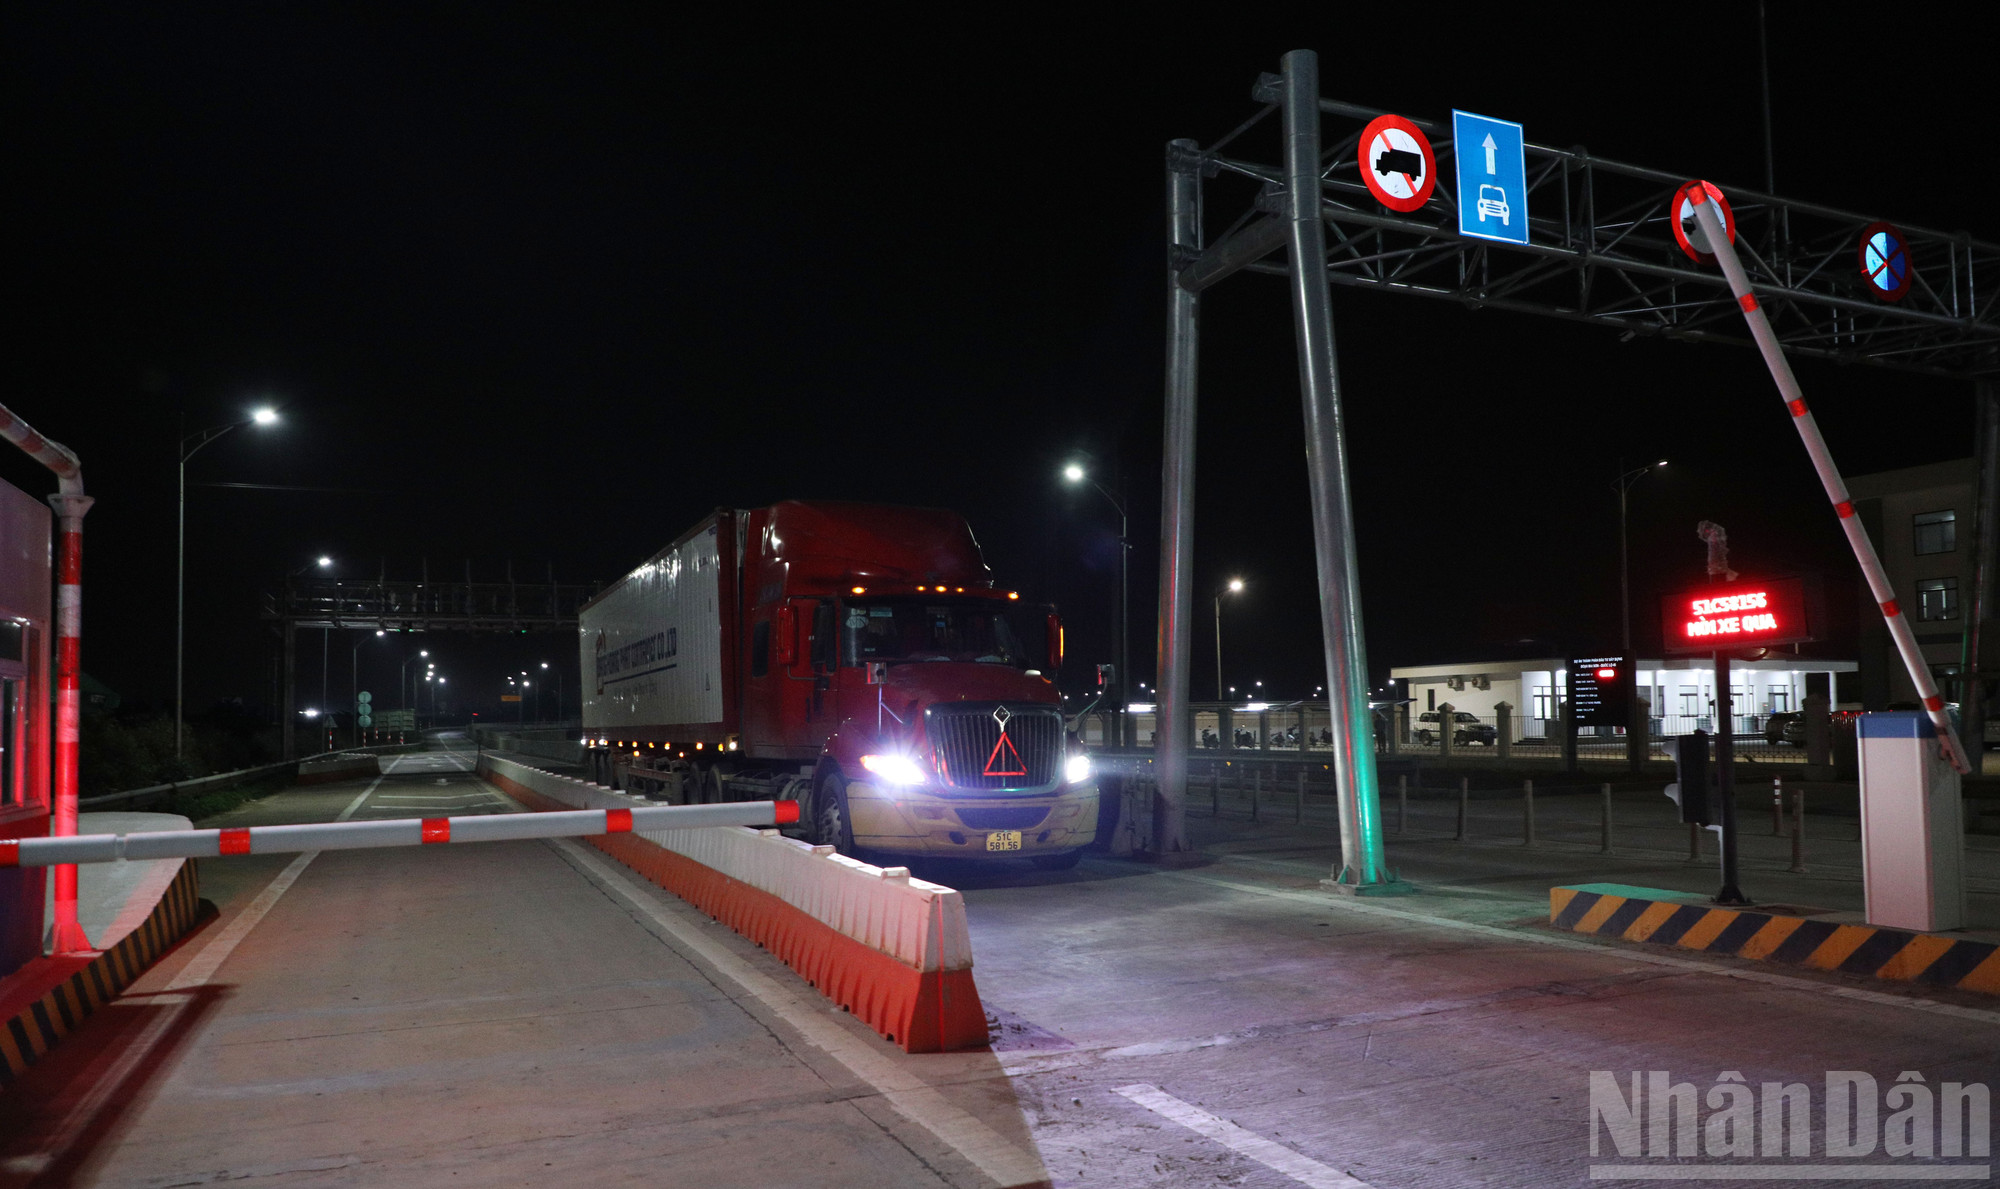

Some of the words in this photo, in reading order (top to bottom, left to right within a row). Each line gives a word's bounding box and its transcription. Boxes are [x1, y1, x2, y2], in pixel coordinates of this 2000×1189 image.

[1692, 592, 1767, 615] 51C58156
[1717, 617, 1741, 633] XE
[1742, 613, 1777, 632] QUA
[996, 833, 1011, 841] 51C
[990, 841, 1018, 851] 581.56
